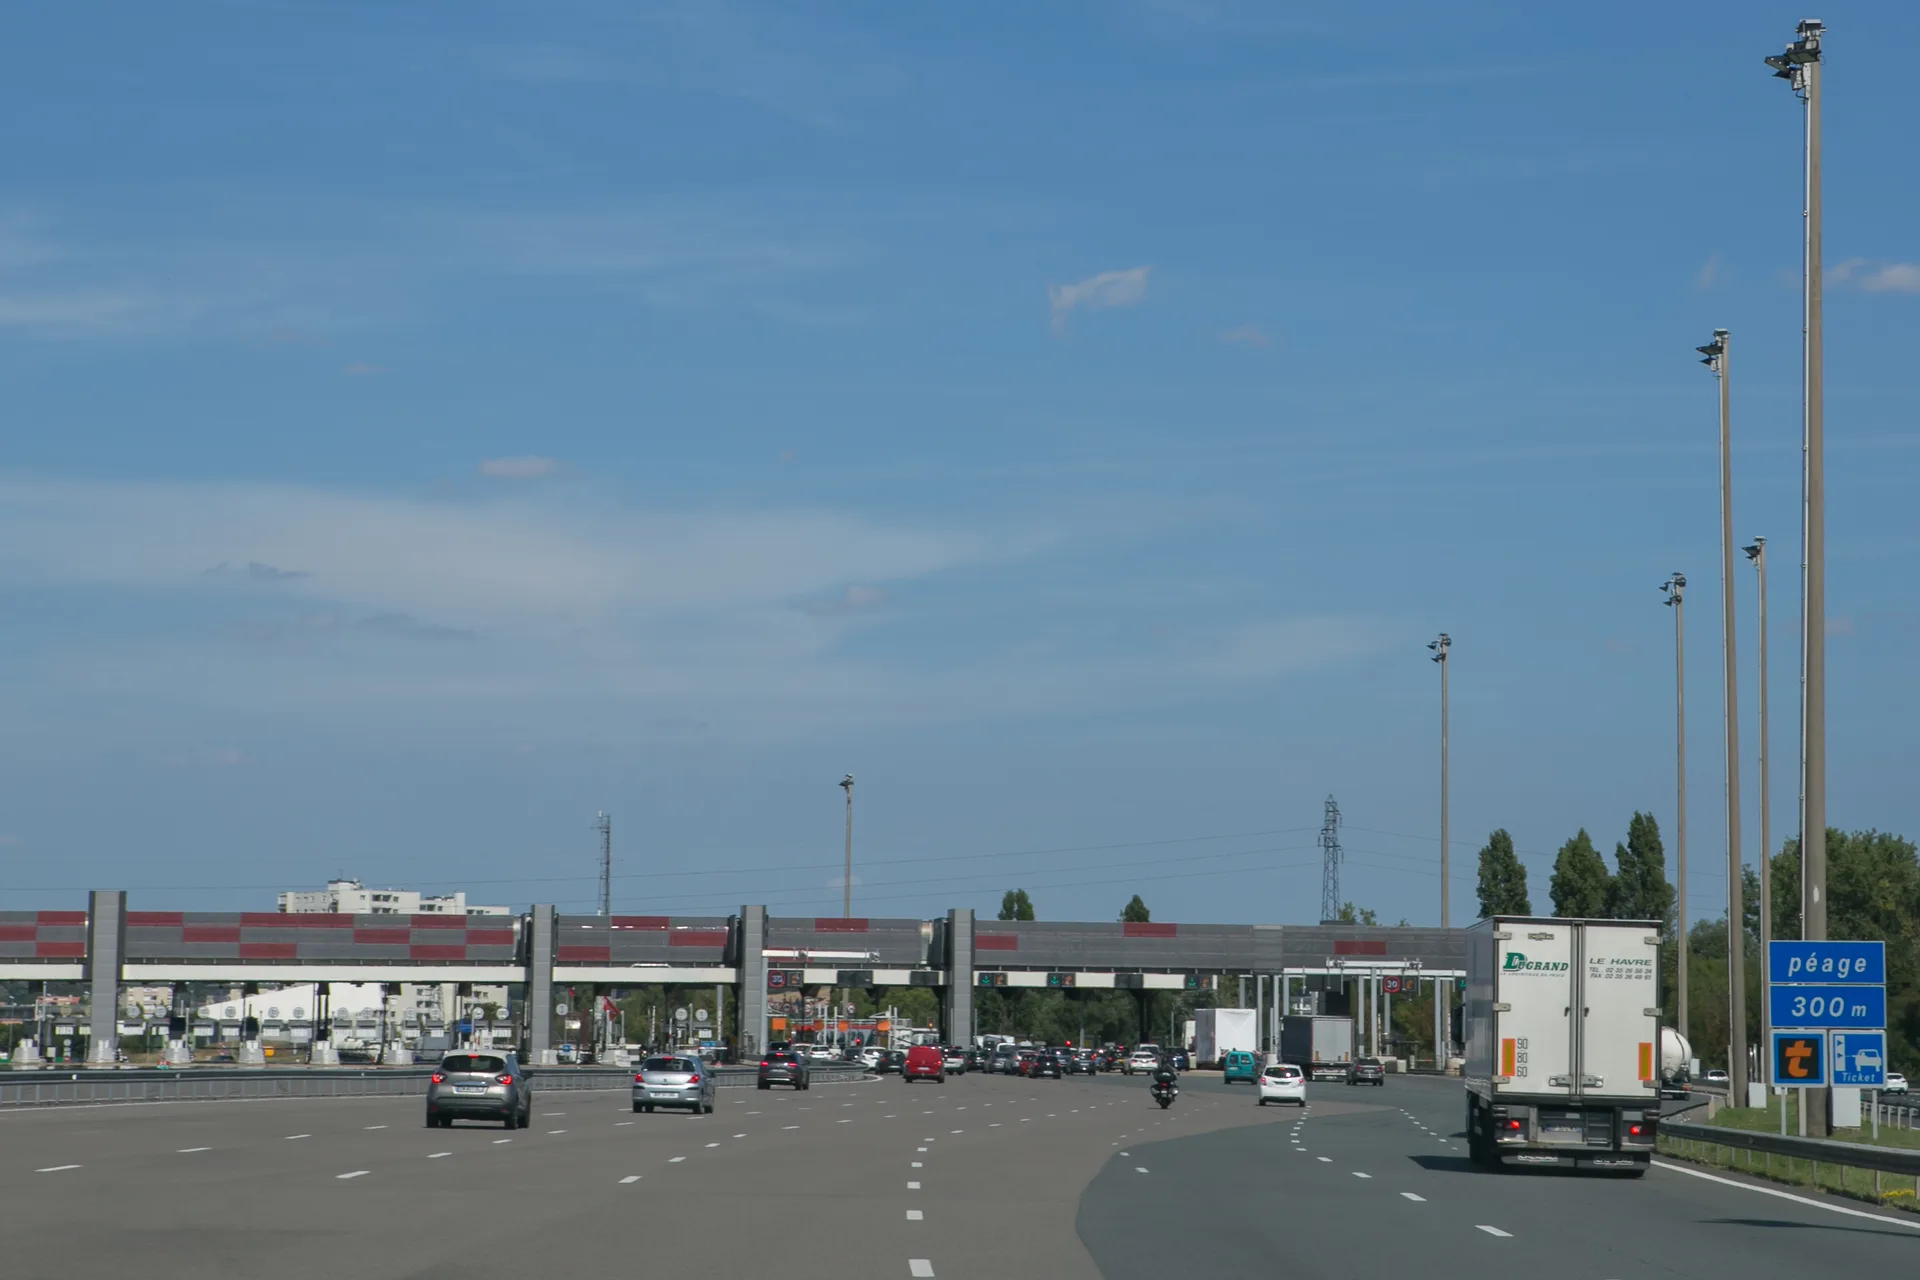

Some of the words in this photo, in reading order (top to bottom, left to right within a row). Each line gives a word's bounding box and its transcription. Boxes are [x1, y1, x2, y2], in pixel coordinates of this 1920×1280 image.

[1502, 952, 1569, 971] DUGRAND
[1589, 957, 1606, 965] LE
[1610, 958, 1653, 966] HAVRE
[1788, 952, 1867, 978] péage
[1386, 980, 1398, 988] 30
[1791, 996, 1845, 1017] 300
[1851, 1005, 1867, 1017] m
[1517, 1038, 1528, 1049] 90
[1517, 1052, 1528, 1063] 80
[1517, 1066, 1527, 1077] 60
[1841, 1072, 1876, 1082] Ticket
